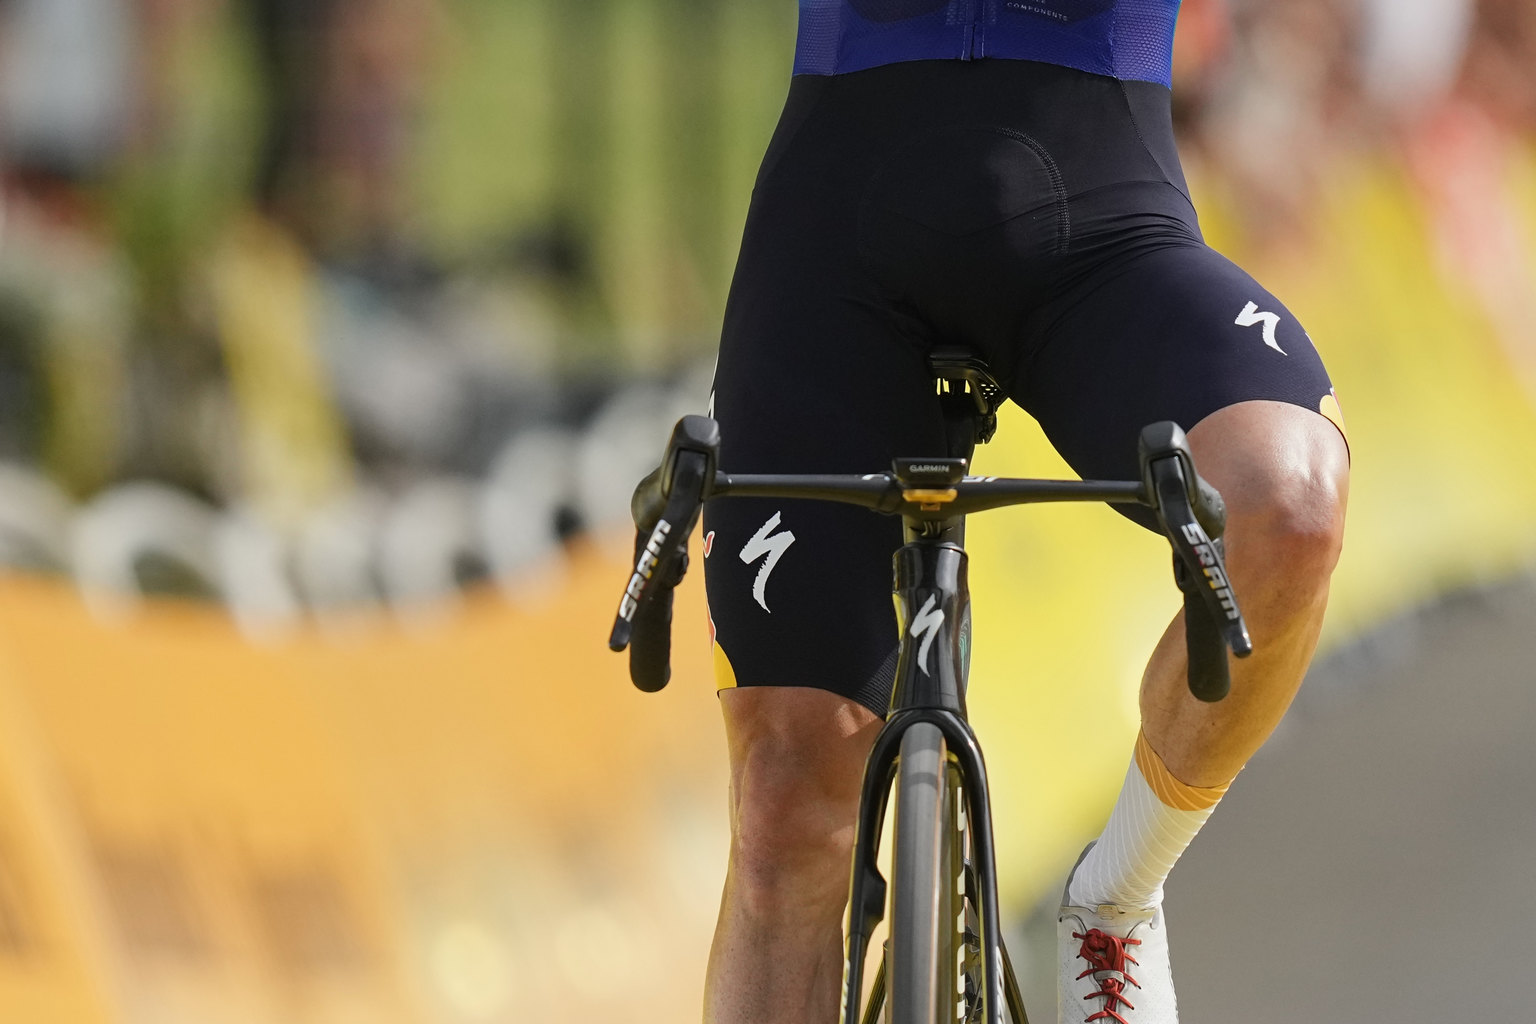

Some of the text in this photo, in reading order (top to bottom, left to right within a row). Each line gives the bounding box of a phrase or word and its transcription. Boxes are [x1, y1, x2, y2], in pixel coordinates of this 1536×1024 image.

[1006, 1, 1068, 21] COMPONENTS
[909, 464, 950, 473] GARMIN
[619, 519, 672, 622] SRAM
[1181, 522, 1240, 620] SRAM
